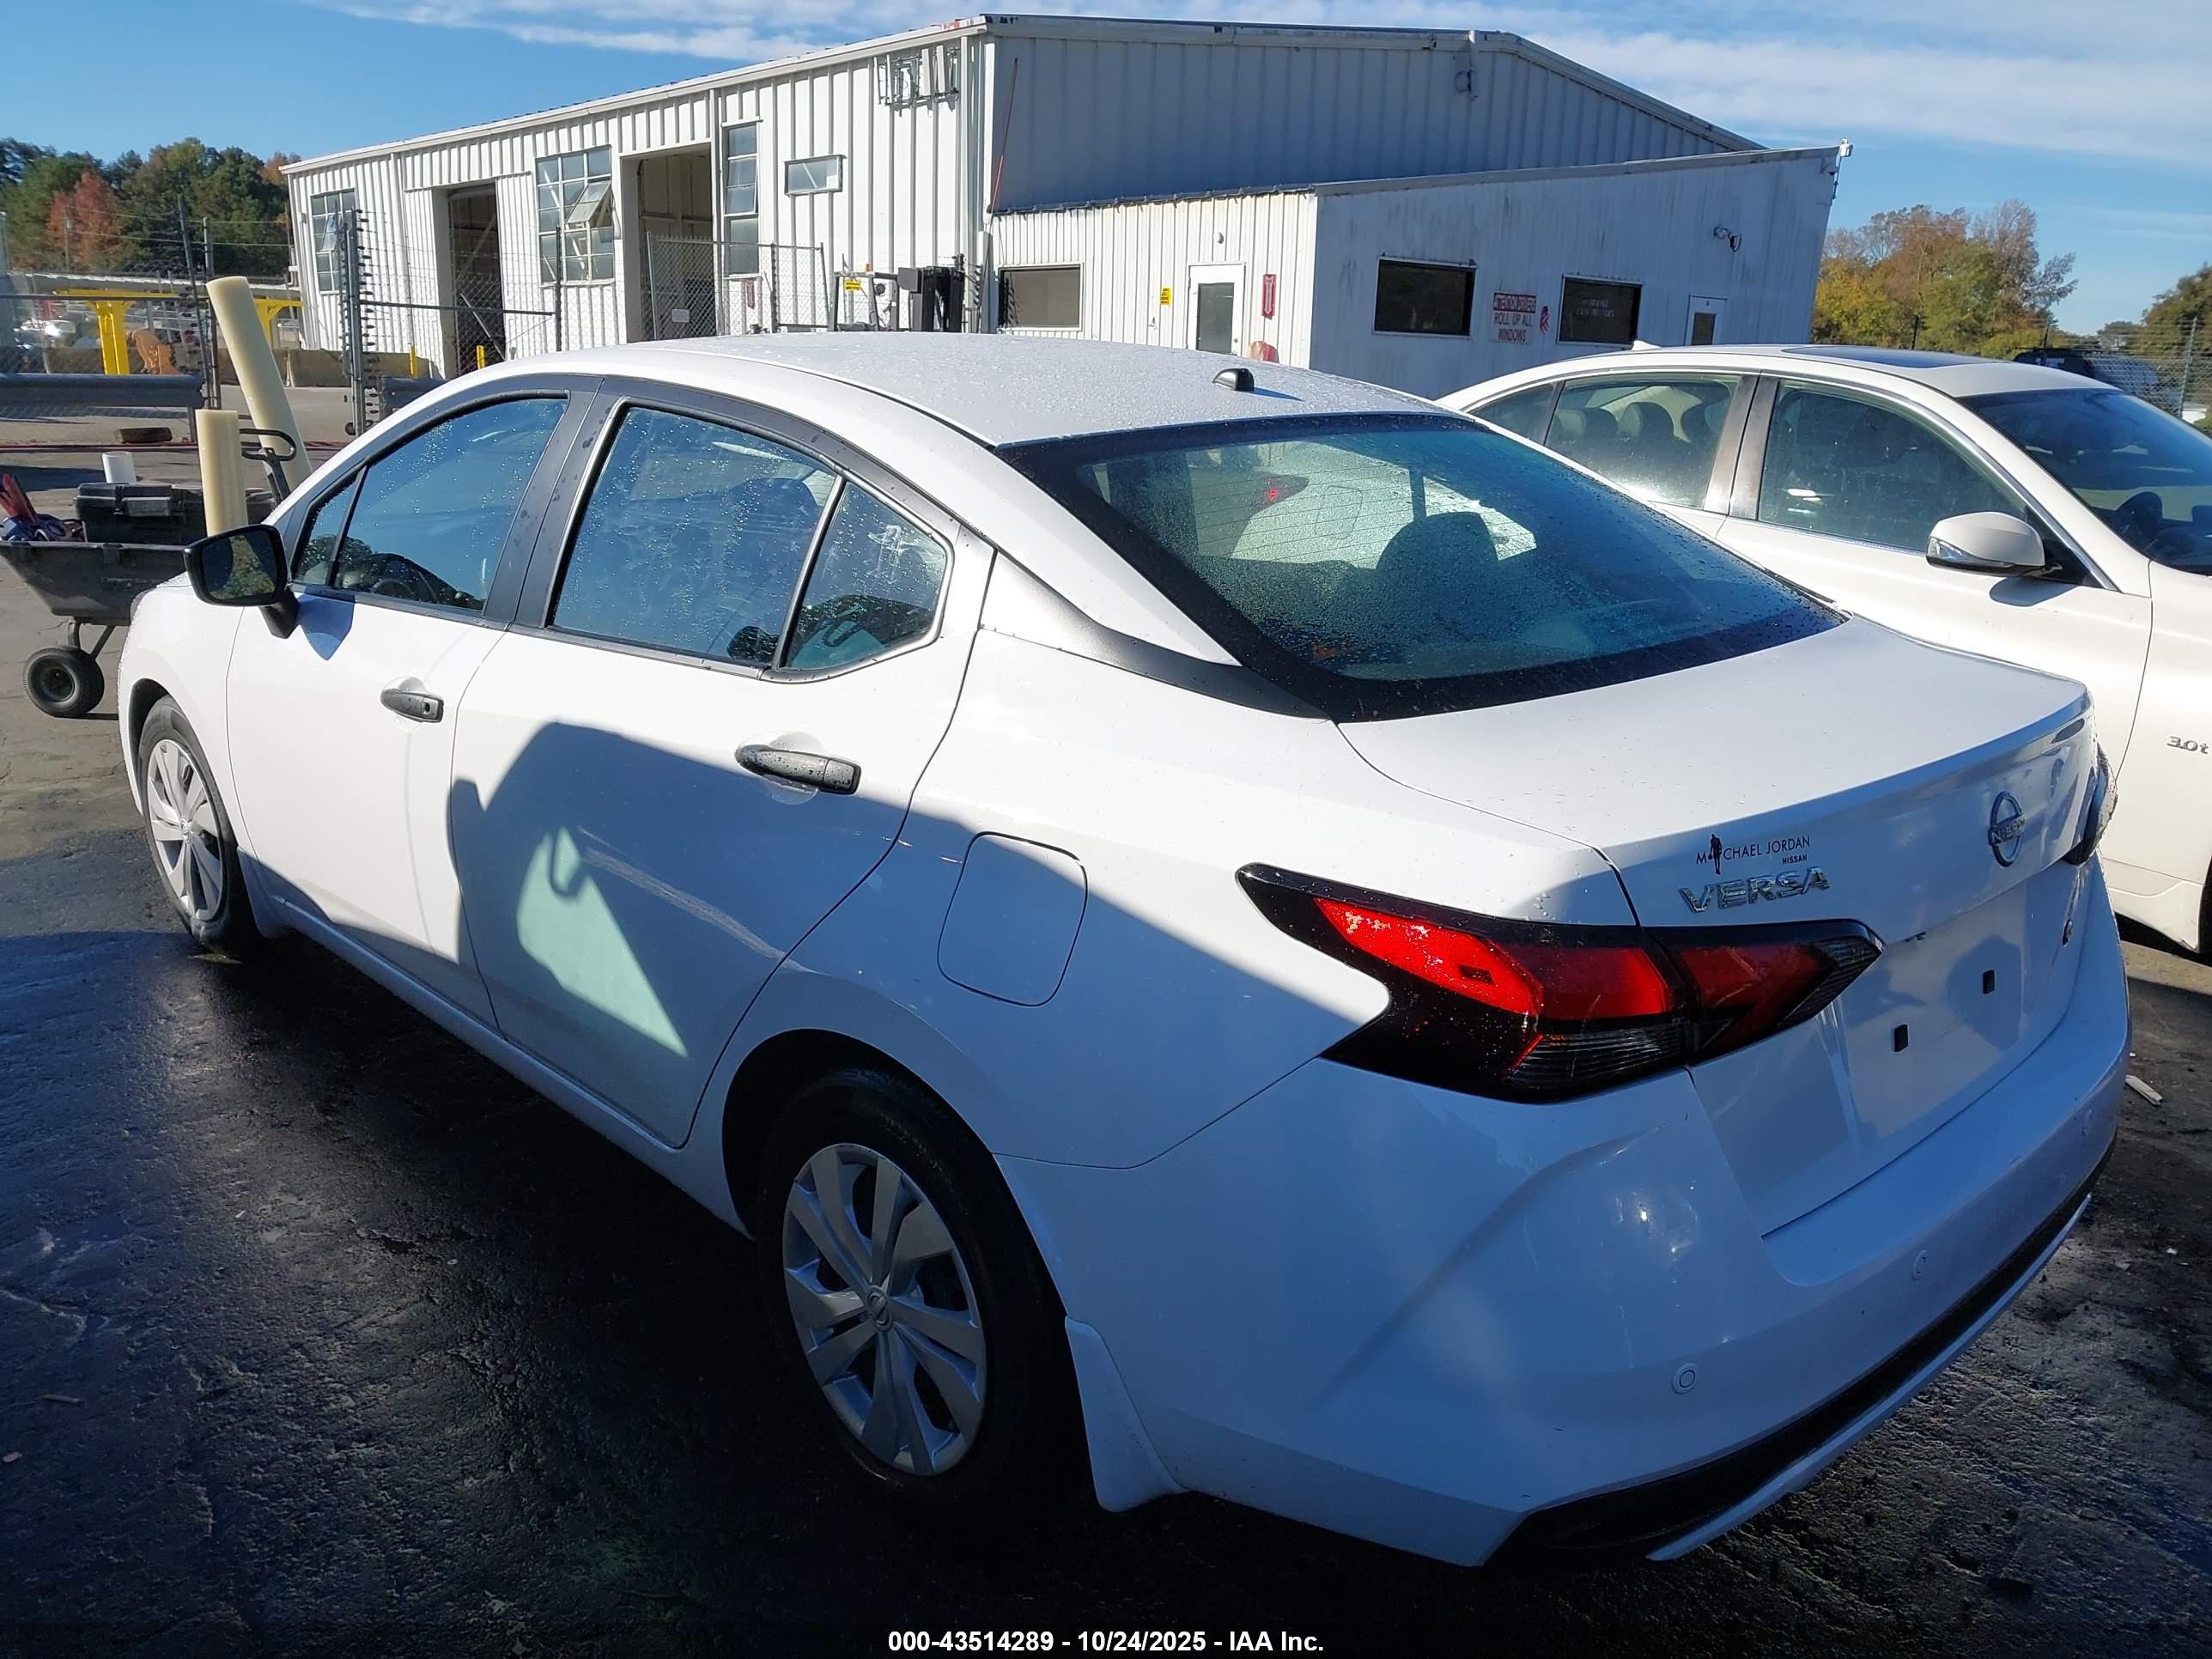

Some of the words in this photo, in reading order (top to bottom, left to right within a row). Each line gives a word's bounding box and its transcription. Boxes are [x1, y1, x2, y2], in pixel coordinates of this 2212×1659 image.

[1494, 312, 1509, 325] ROLL
[1512, 314, 1521, 325] UP
[1522, 314, 1532, 327] ALL
[1498, 328, 1526, 343] WINDOWS
[1696, 842, 1762, 865] MCHAEL
[1765, 836, 1810, 854] JORDAN
[1782, 854, 1808, 865] NISSAN
[1677, 866, 1831, 914] VERSA
